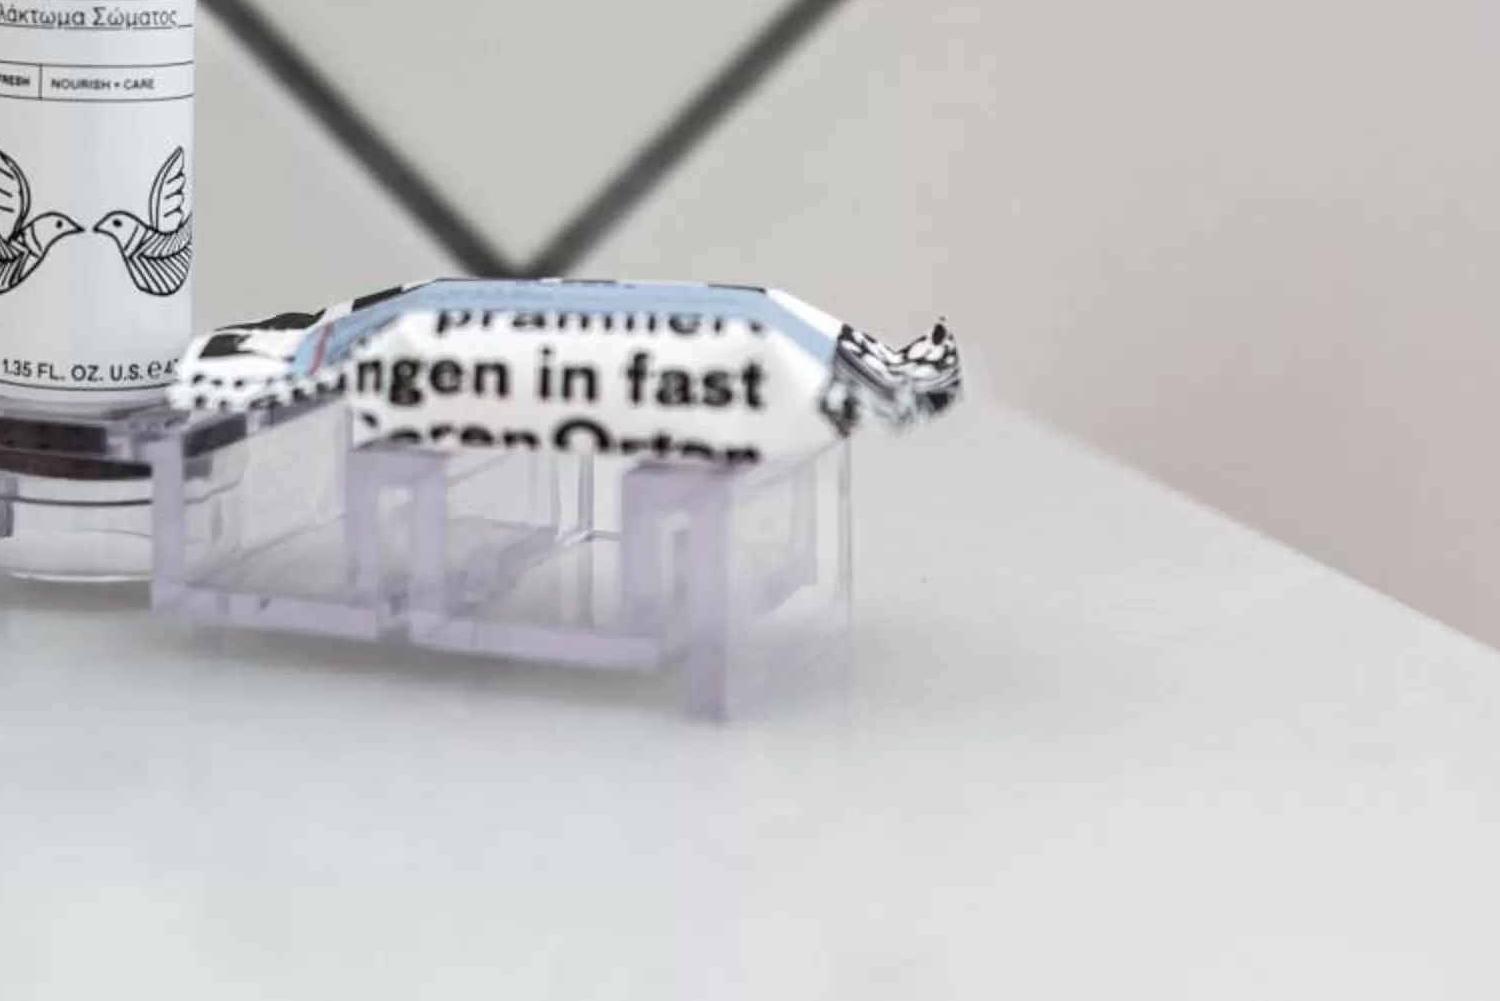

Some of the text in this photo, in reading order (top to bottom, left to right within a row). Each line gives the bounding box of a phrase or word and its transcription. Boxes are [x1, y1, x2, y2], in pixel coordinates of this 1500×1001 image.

[92, 5, 178, 28] Σώματος
[51, 78, 111, 90] NOURISH
[123, 78, 155, 90] CARE
[2, 358, 32, 378] 1.35
[37, 362, 66, 381] FL.
[71, 364, 104, 382] OZ.
[110, 363, 144, 382] U.S.
[539, 344, 599, 402] in
[626, 349, 767, 410] fast
